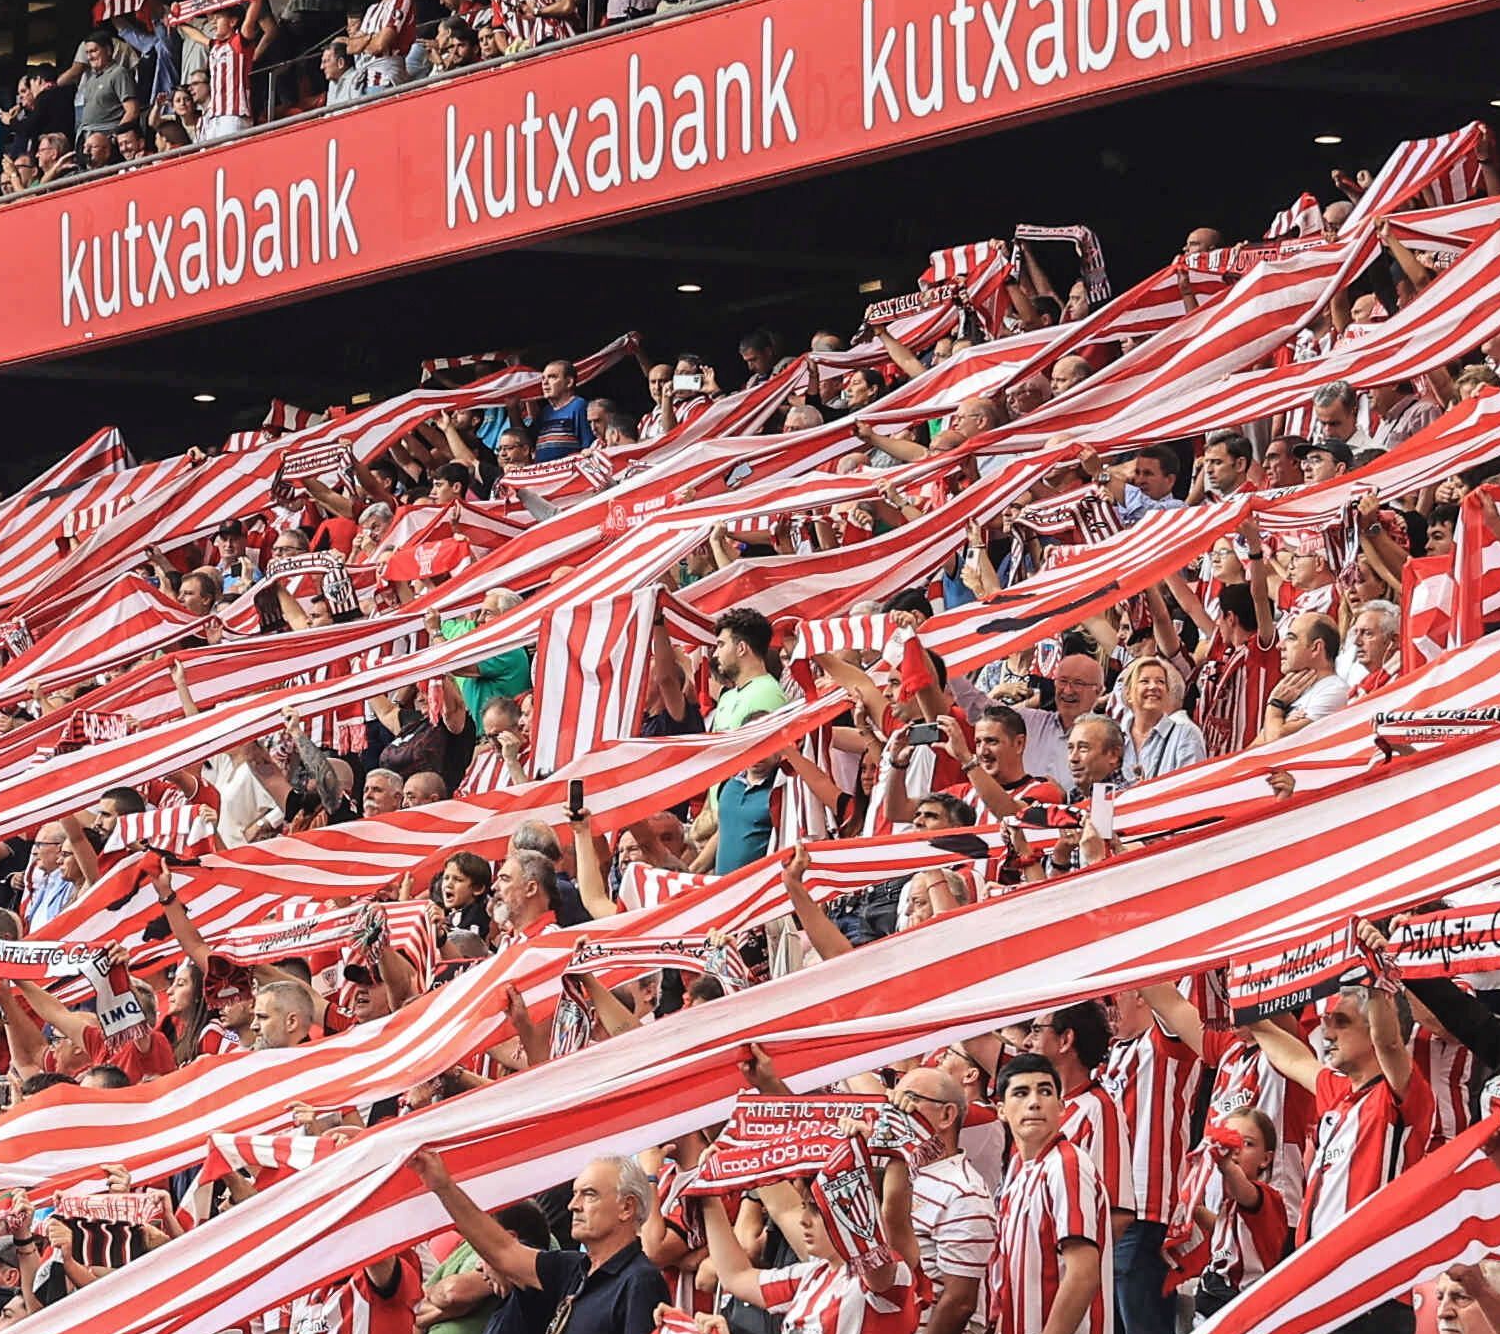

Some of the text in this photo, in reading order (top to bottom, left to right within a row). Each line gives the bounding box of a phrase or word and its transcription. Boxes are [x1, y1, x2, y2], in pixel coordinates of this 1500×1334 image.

[438, 11, 797, 229] kutxabank
[54, 133, 359, 326] kutxabank
[1395, 913, 1487, 972] Athletic
[100, 1000, 141, 1028] IMQ
[1257, 989, 1313, 1017] TXAPELDUN
[746, 1101, 865, 1119] ATHLETIC CLUB
